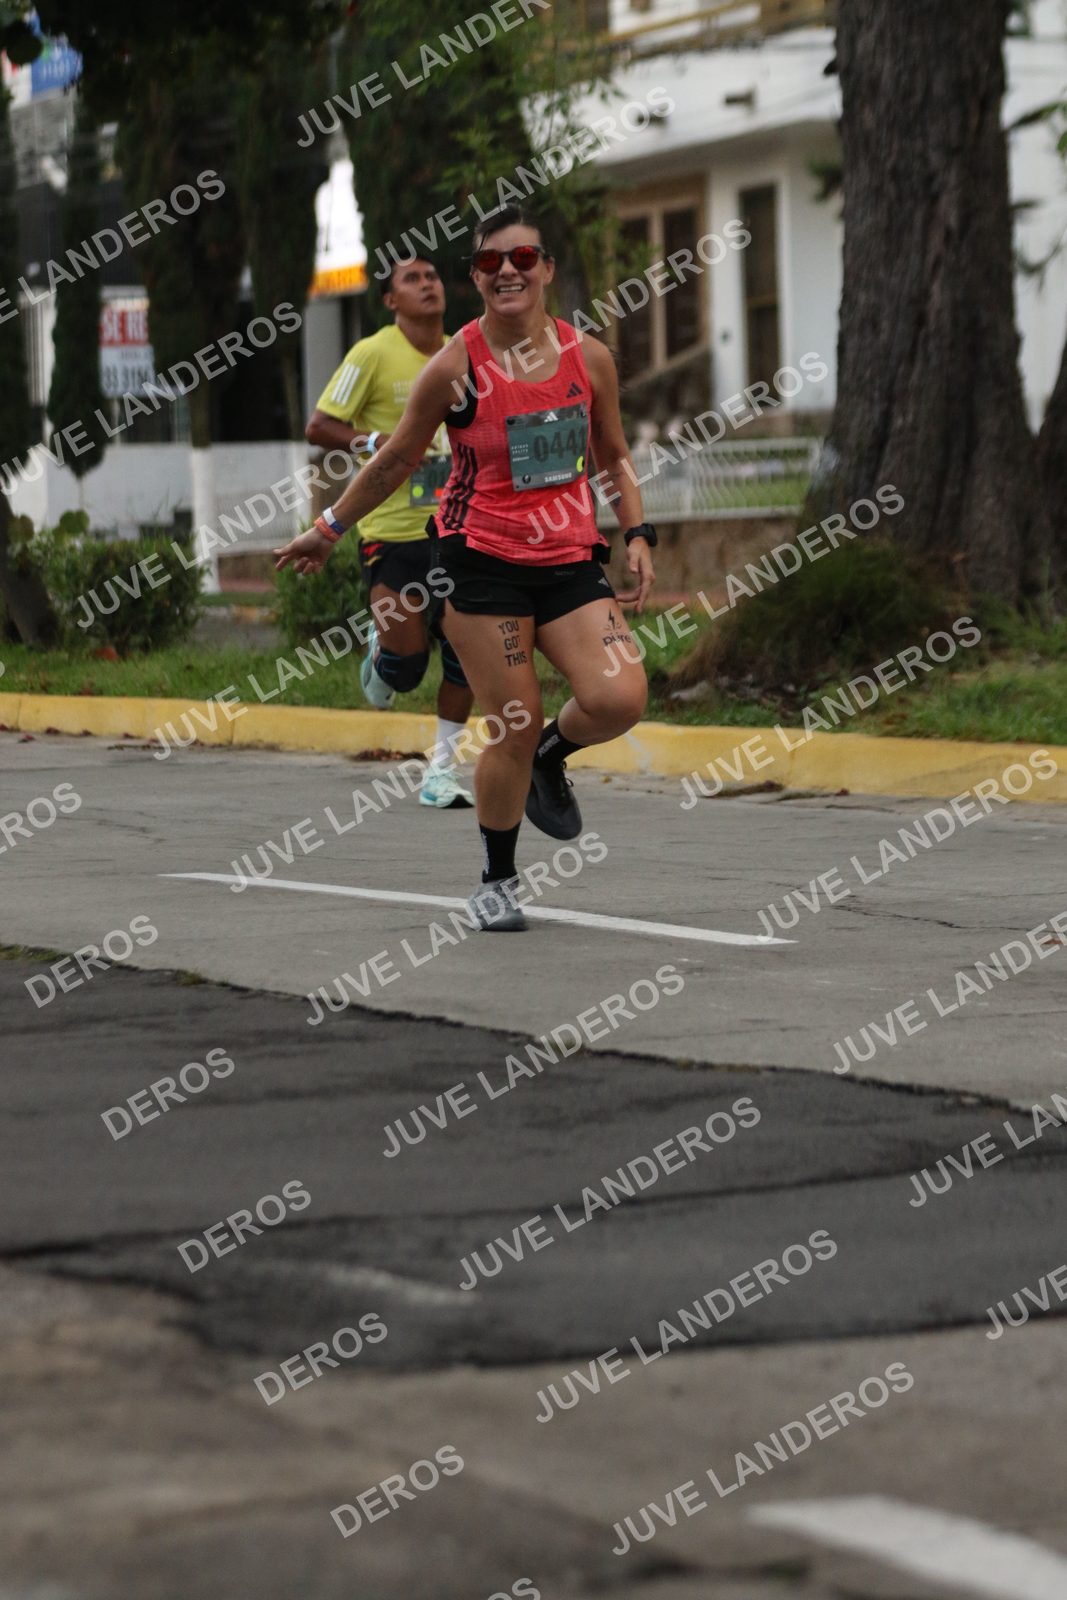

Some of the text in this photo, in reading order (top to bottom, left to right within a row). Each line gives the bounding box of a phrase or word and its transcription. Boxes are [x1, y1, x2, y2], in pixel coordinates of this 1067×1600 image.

[544, 472, 573, 483] SAMSUNG
[498, 619, 520, 635] YOU
[504, 650, 528, 667] THIS
